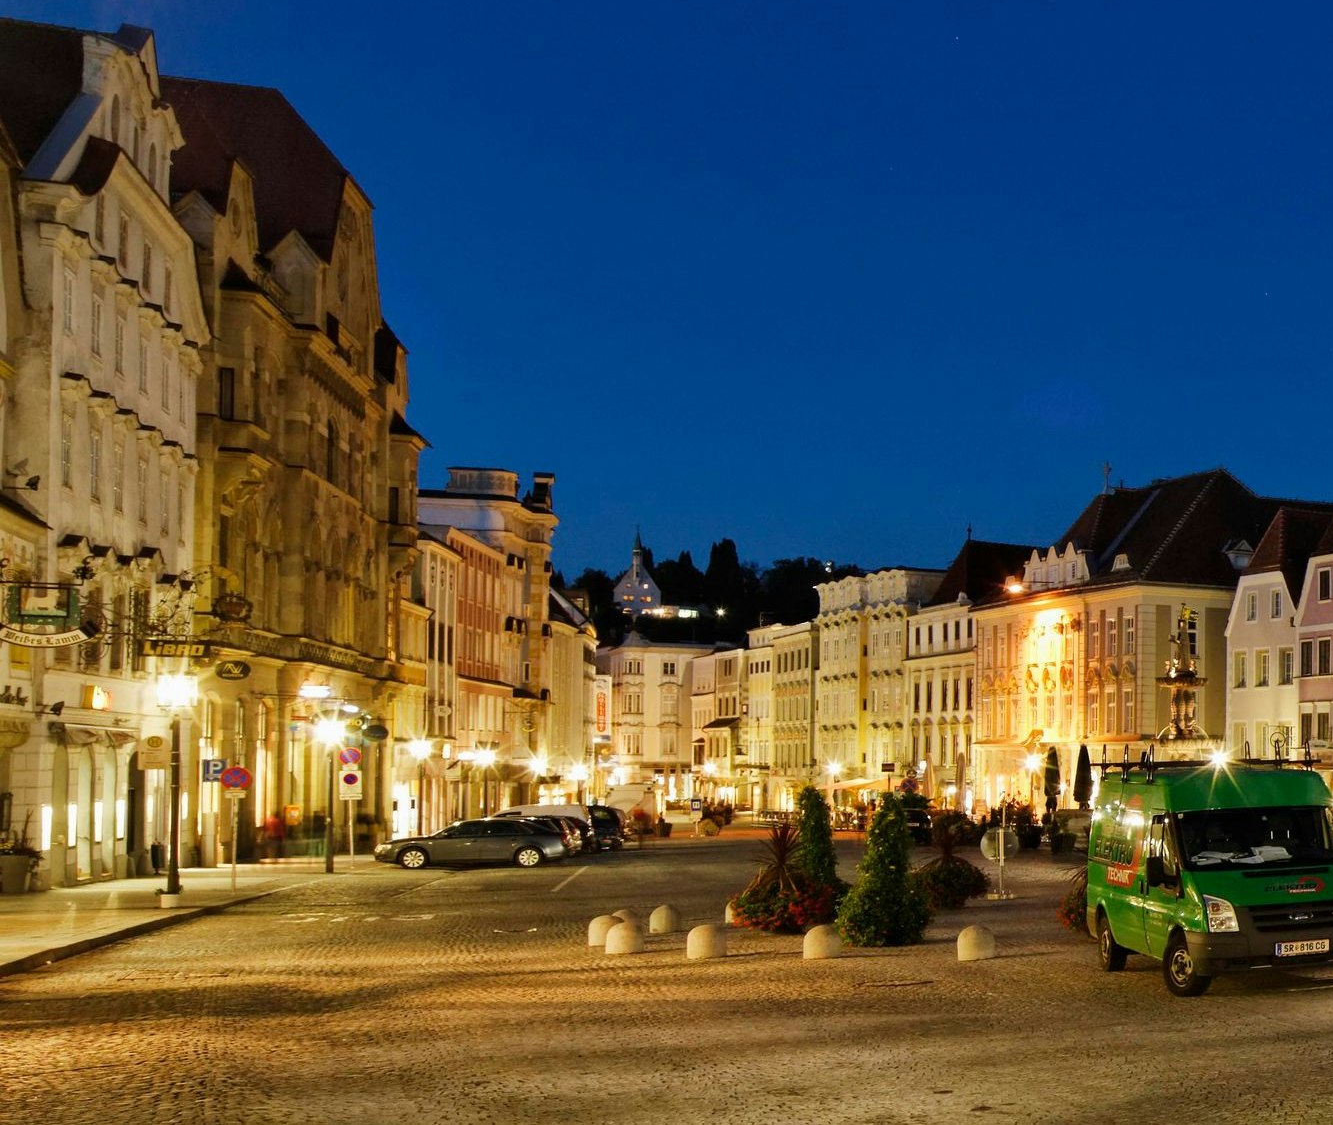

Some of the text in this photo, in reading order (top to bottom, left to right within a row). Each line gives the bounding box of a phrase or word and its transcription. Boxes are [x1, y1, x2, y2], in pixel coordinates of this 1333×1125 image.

[45, 632, 81, 645] Lamm
[210, 761, 222, 775] P
[1283, 941, 1326, 953] SR 816 CG
